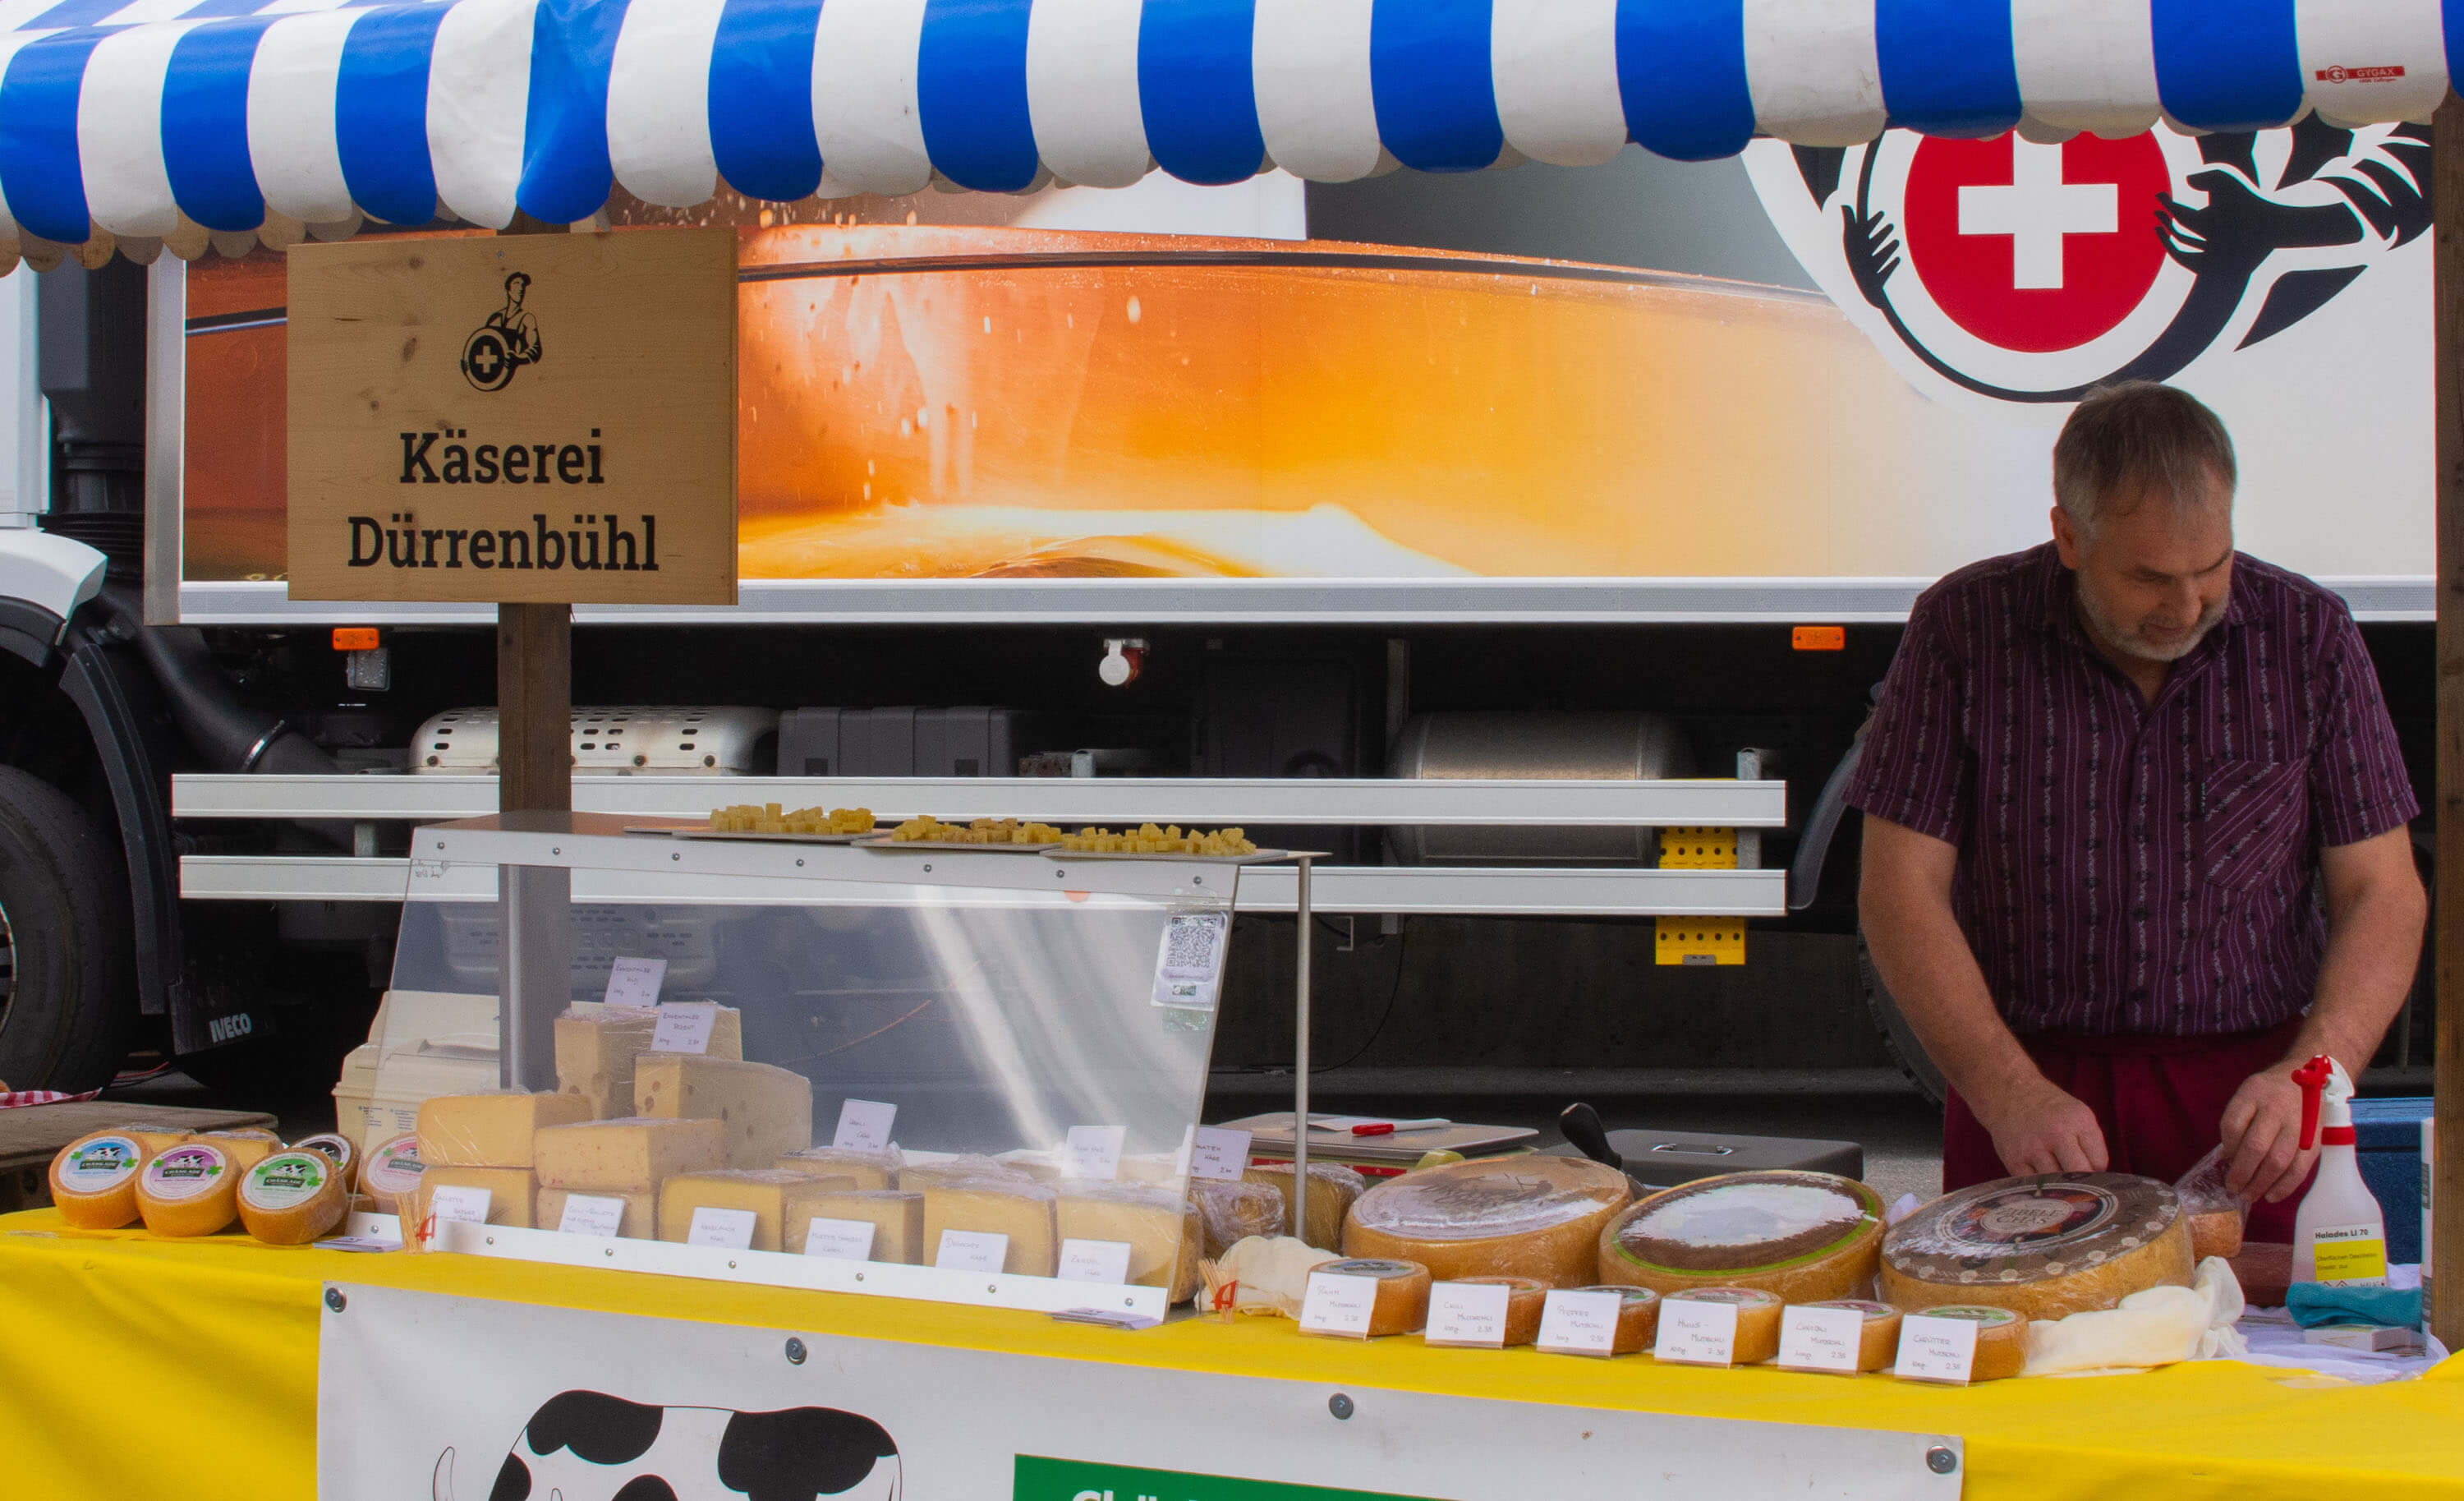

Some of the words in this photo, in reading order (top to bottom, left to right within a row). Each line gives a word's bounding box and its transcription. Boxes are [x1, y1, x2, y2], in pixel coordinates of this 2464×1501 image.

[2356, 67, 2395, 78] GYGAX
[399, 428, 605, 484] Käserei
[347, 513, 660, 571] Dürrenbühl
[209, 1012, 252, 1043] IVECO
[2315, 1229, 2348, 1239] Halades
